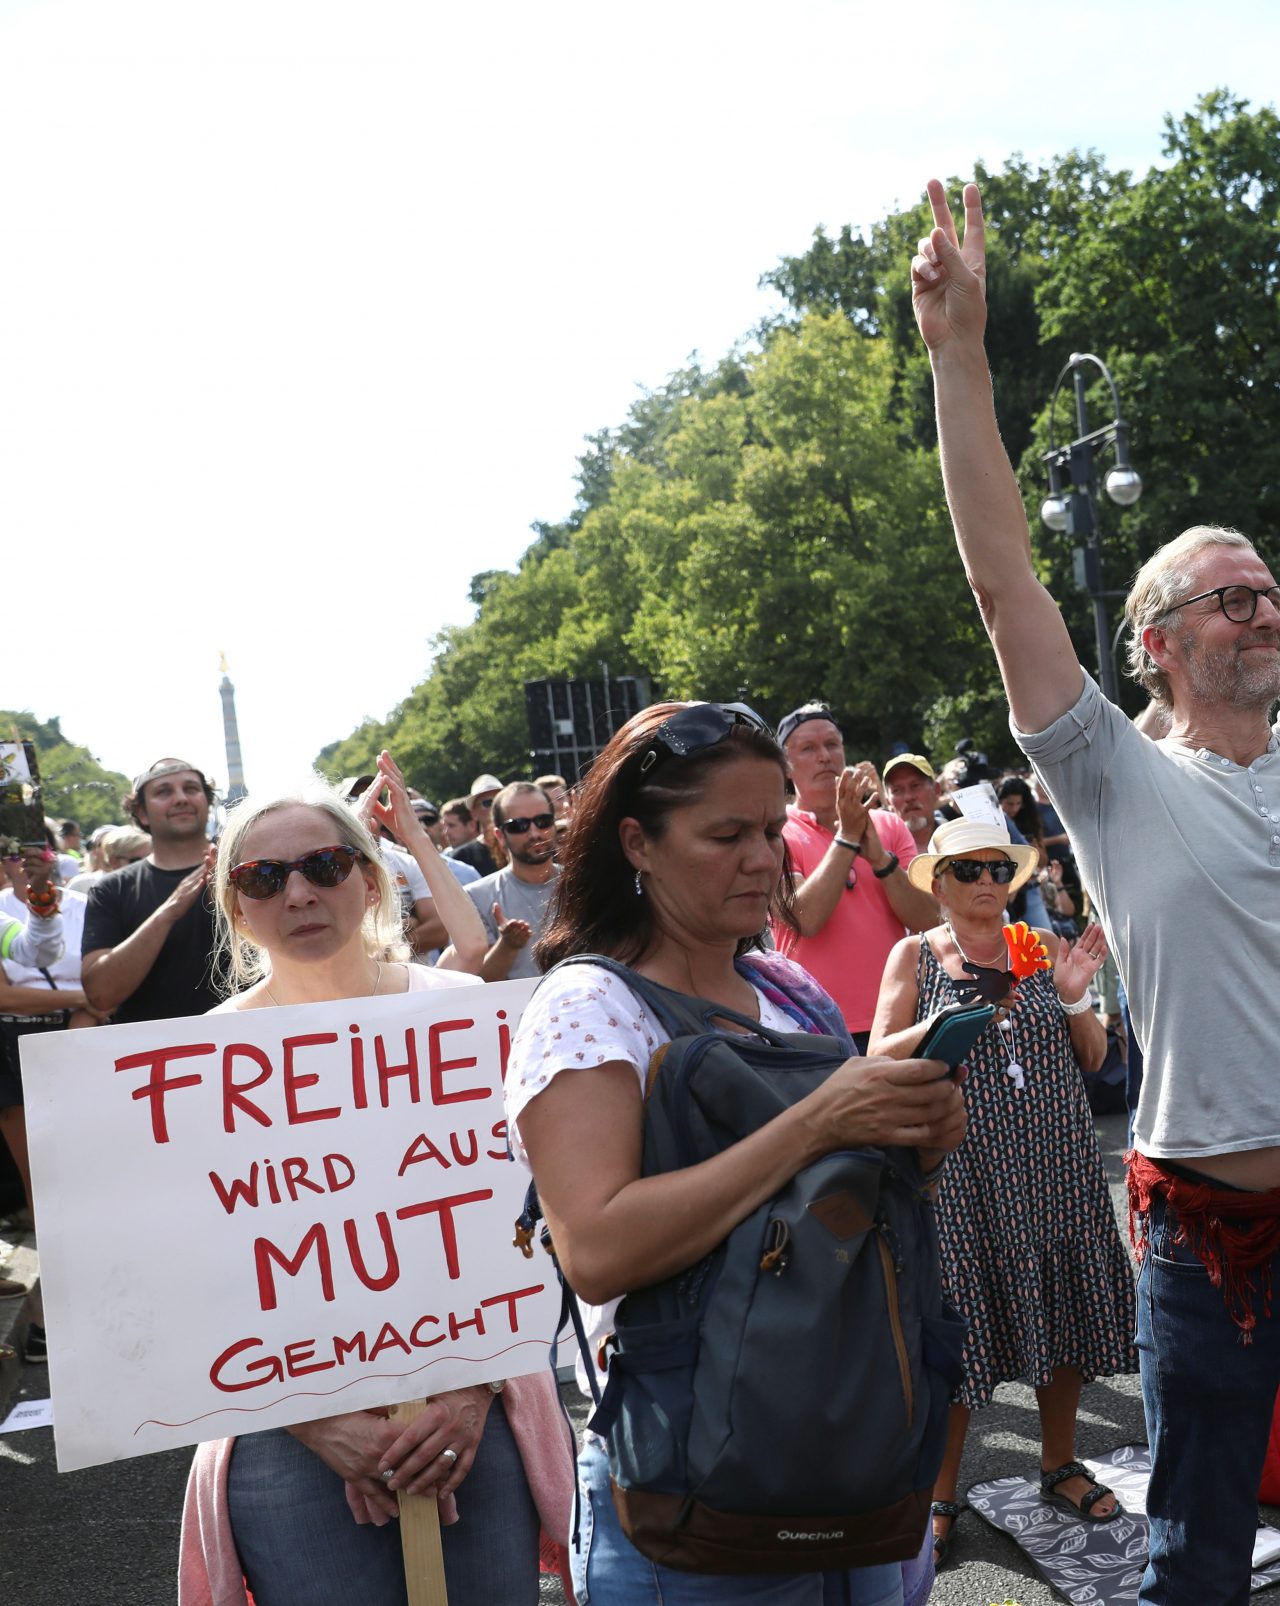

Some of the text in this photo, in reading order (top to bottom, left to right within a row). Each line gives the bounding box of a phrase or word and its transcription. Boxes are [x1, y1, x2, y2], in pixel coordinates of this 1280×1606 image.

[114, 1009, 511, 1144] FREiHEi
[398, 1119, 509, 1177] AUS
[254, 1188, 493, 1311] MUT
[209, 1284, 545, 1393] GEMACHT
[776, 1529, 845, 1541] Quechua
